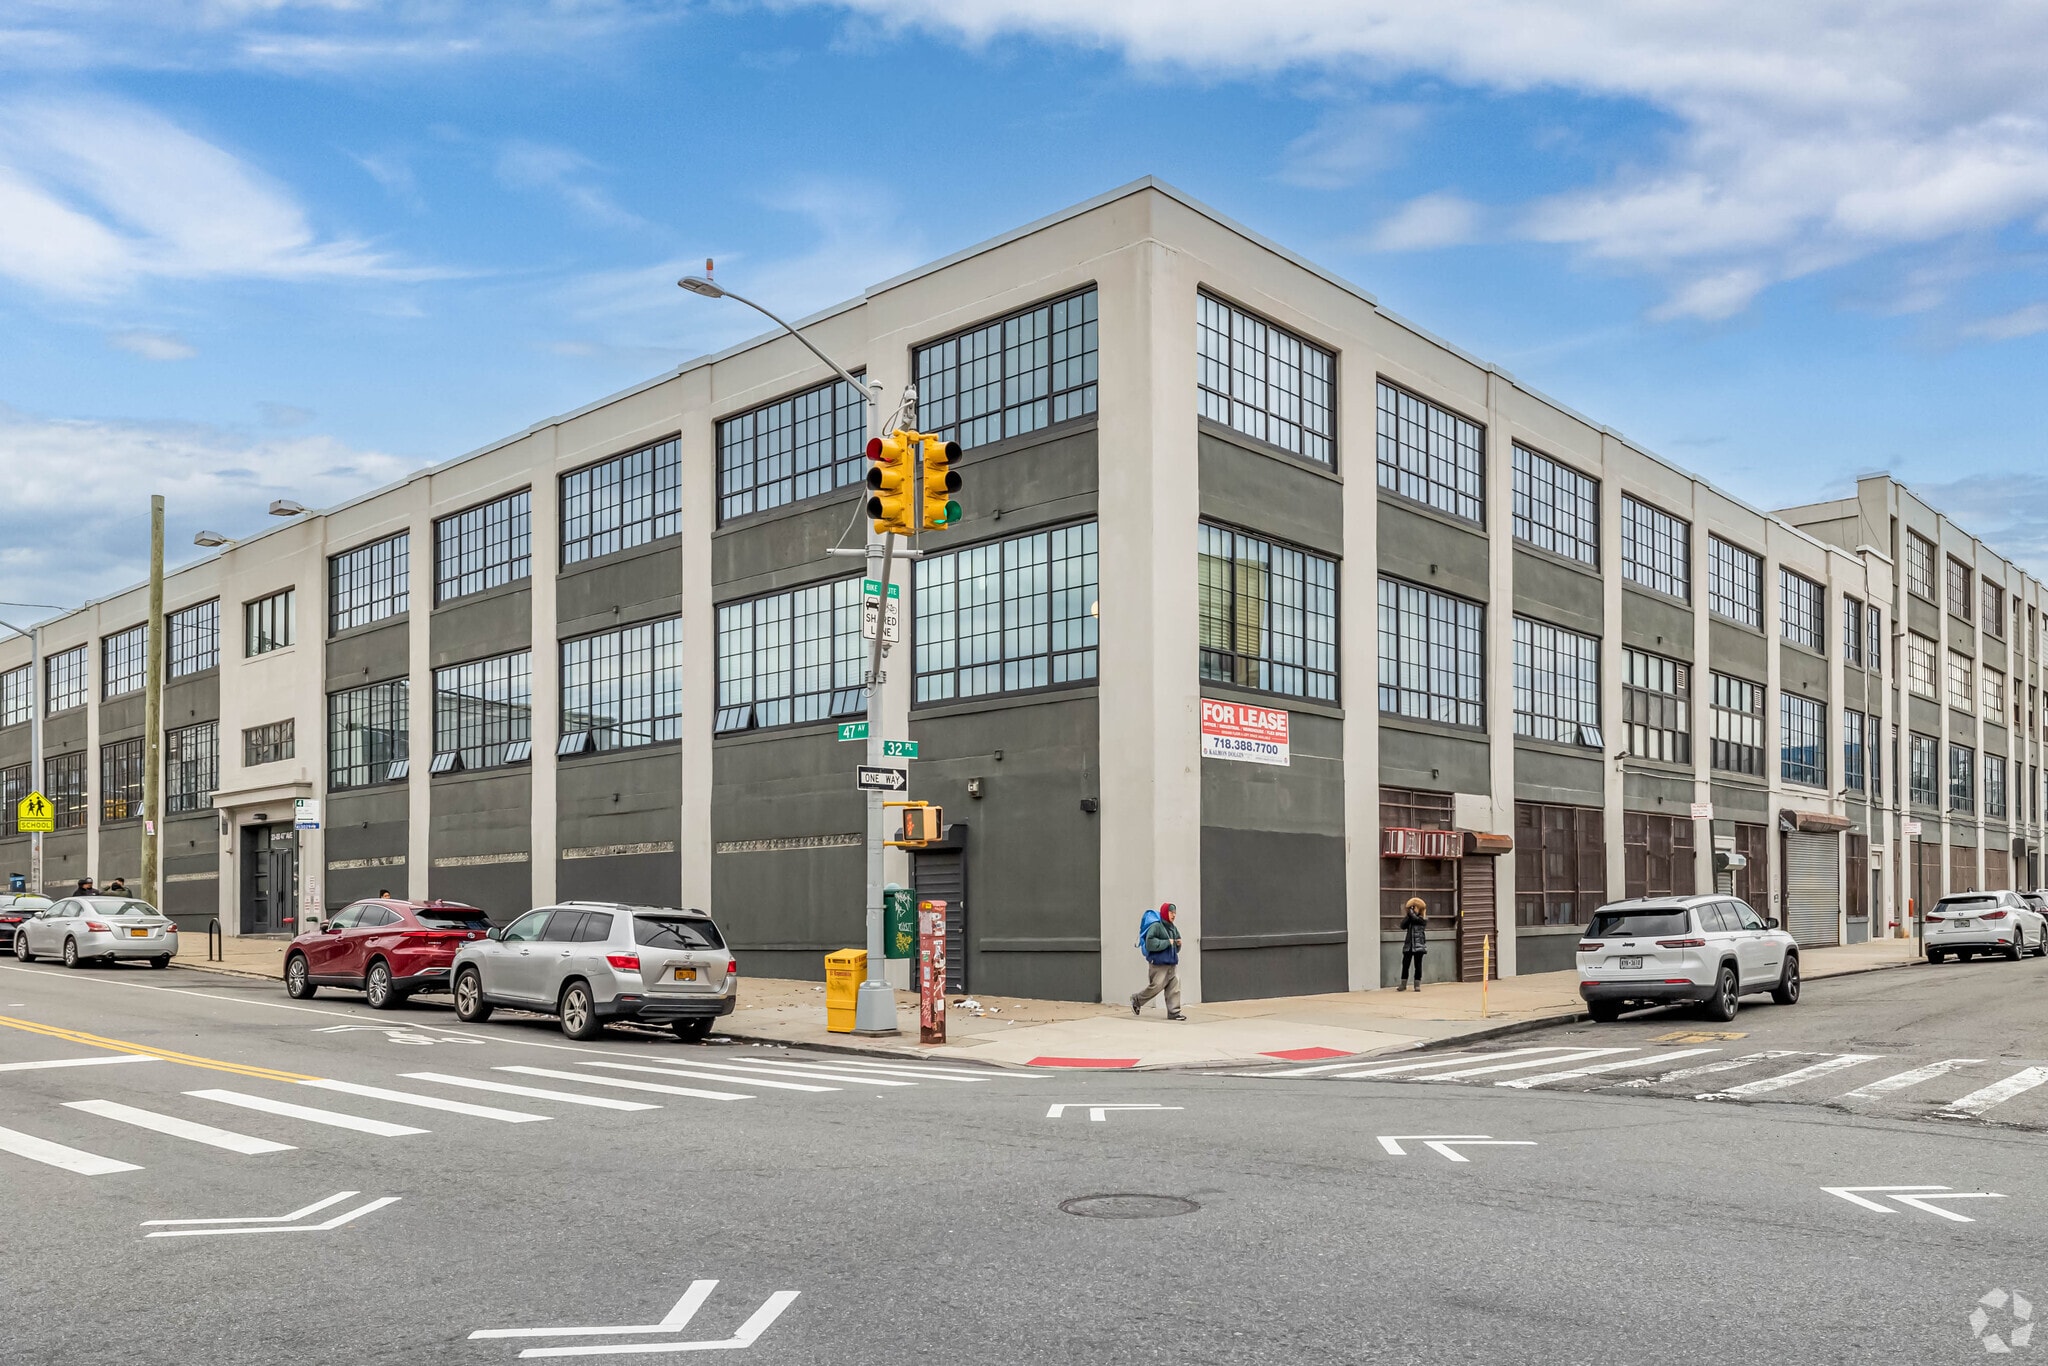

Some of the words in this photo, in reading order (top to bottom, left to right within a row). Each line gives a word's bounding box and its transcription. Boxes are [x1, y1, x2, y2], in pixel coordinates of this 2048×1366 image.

[866, 583, 878, 592] BIKE
[866, 613, 897, 626] SHRED
[871, 625, 892, 637] LNE
[1202, 702, 1235, 724] FOR
[1239, 707, 1286, 731] LEASE
[843, 725, 855, 738] 47
[858, 724, 865, 732] AV
[887, 742, 903, 756] 32
[905, 743, 913, 751] PL
[1213, 737, 1278, 755] 718.388.7700
[865, 773, 880, 783] ONE
[885, 775, 900, 784] WAY
[16, 880, 22, 888] P
